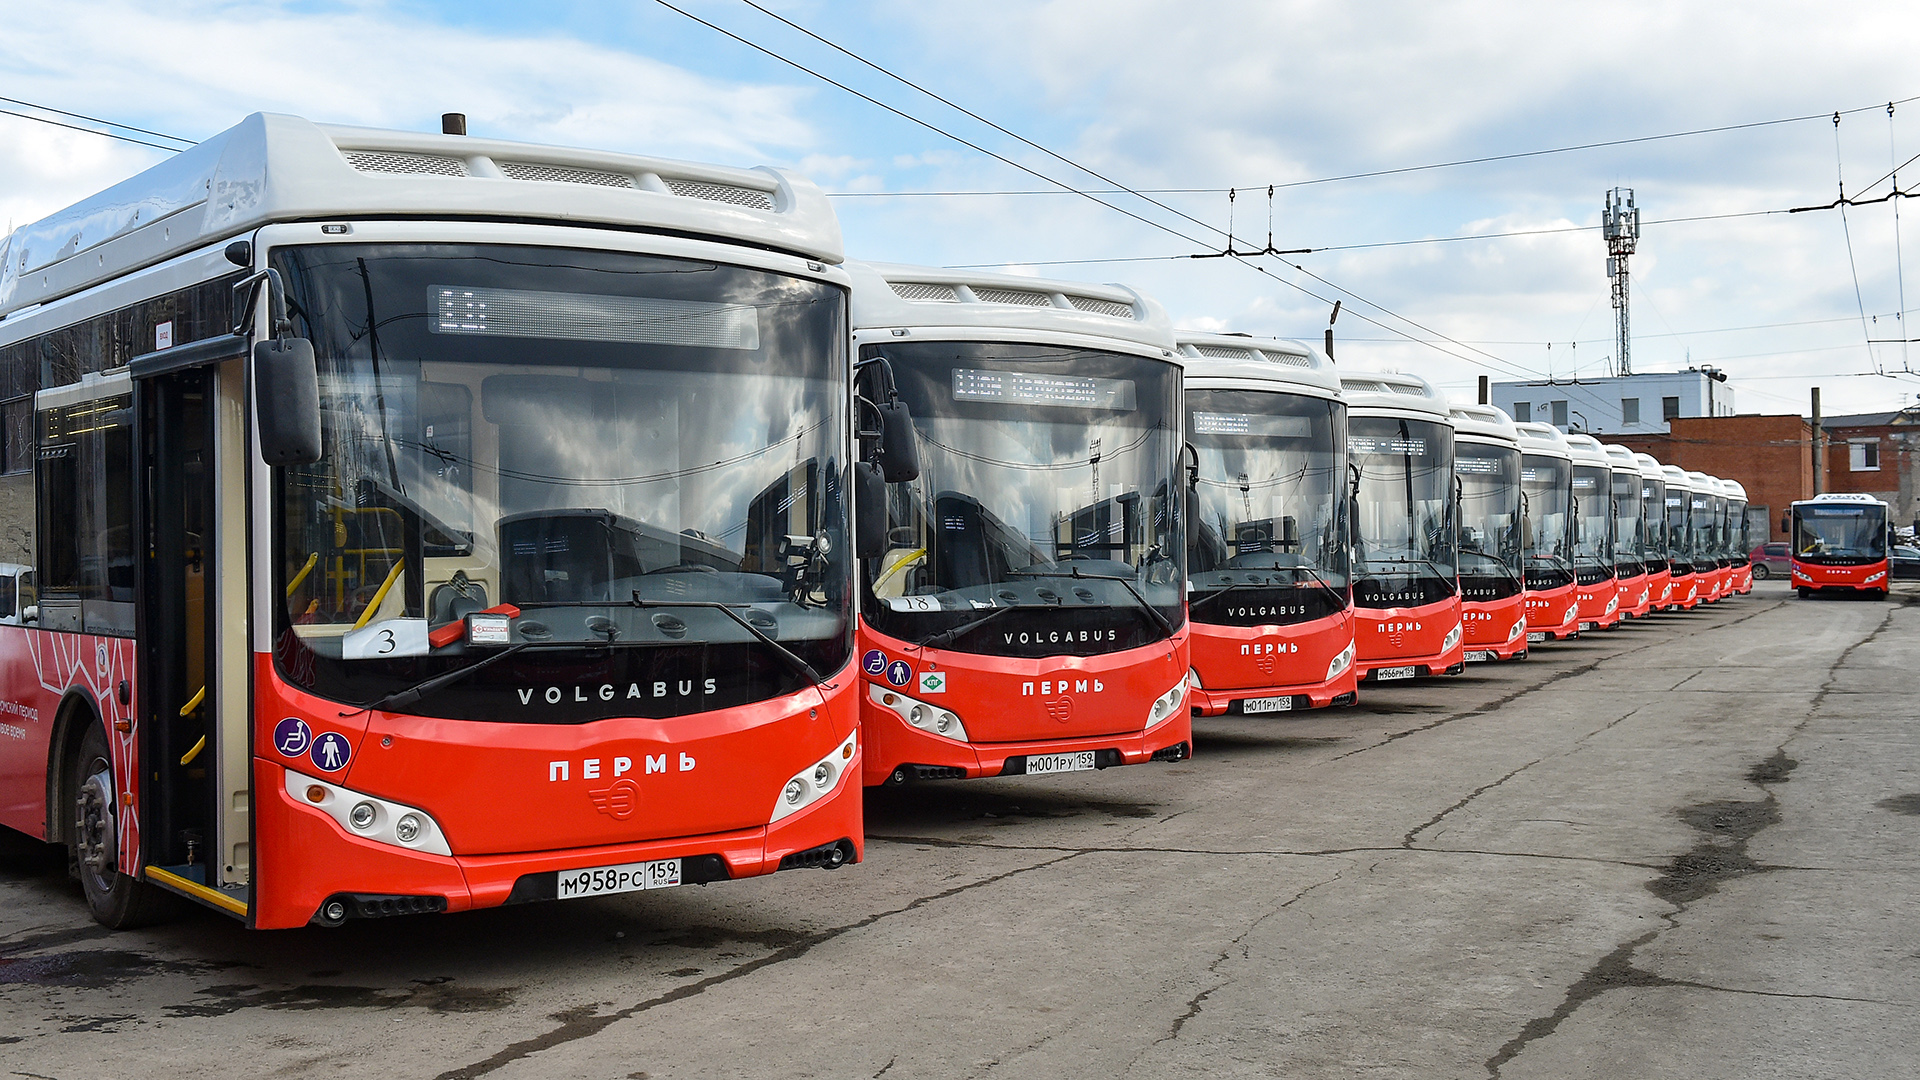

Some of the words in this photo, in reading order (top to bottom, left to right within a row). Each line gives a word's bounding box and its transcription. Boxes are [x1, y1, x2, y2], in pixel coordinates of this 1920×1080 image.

[1365, 592, 1424, 601] VOLGABUS
[1461, 588, 1496, 596] LGABUS
[905, 597, 929, 610] 18
[1525, 600, 1550, 608] ЕРМЬ
[1228, 605, 1305, 617] VOLGABUS
[1463, 612, 1492, 621] ЕРМЬ
[1378, 621, 1422, 633] ПЕРМЬ
[378, 629, 396, 654] 3
[1004, 629, 1116, 645] VOLGABUS
[1241, 642, 1298, 655] ПЕРМЬ
[518, 678, 717, 706] VOLGABUS
[1022, 679, 1104, 696] ПЕРМЬ
[1245, 700, 1277, 711] М011РУ
[1279, 697, 1290, 706] 159
[549, 752, 696, 782] ПЕРМЬ
[1029, 756, 1073, 772] М001РУ
[1077, 753, 1093, 763] 159
[564, 869, 643, 895] М958РС
[648, 861, 676, 879] 159
